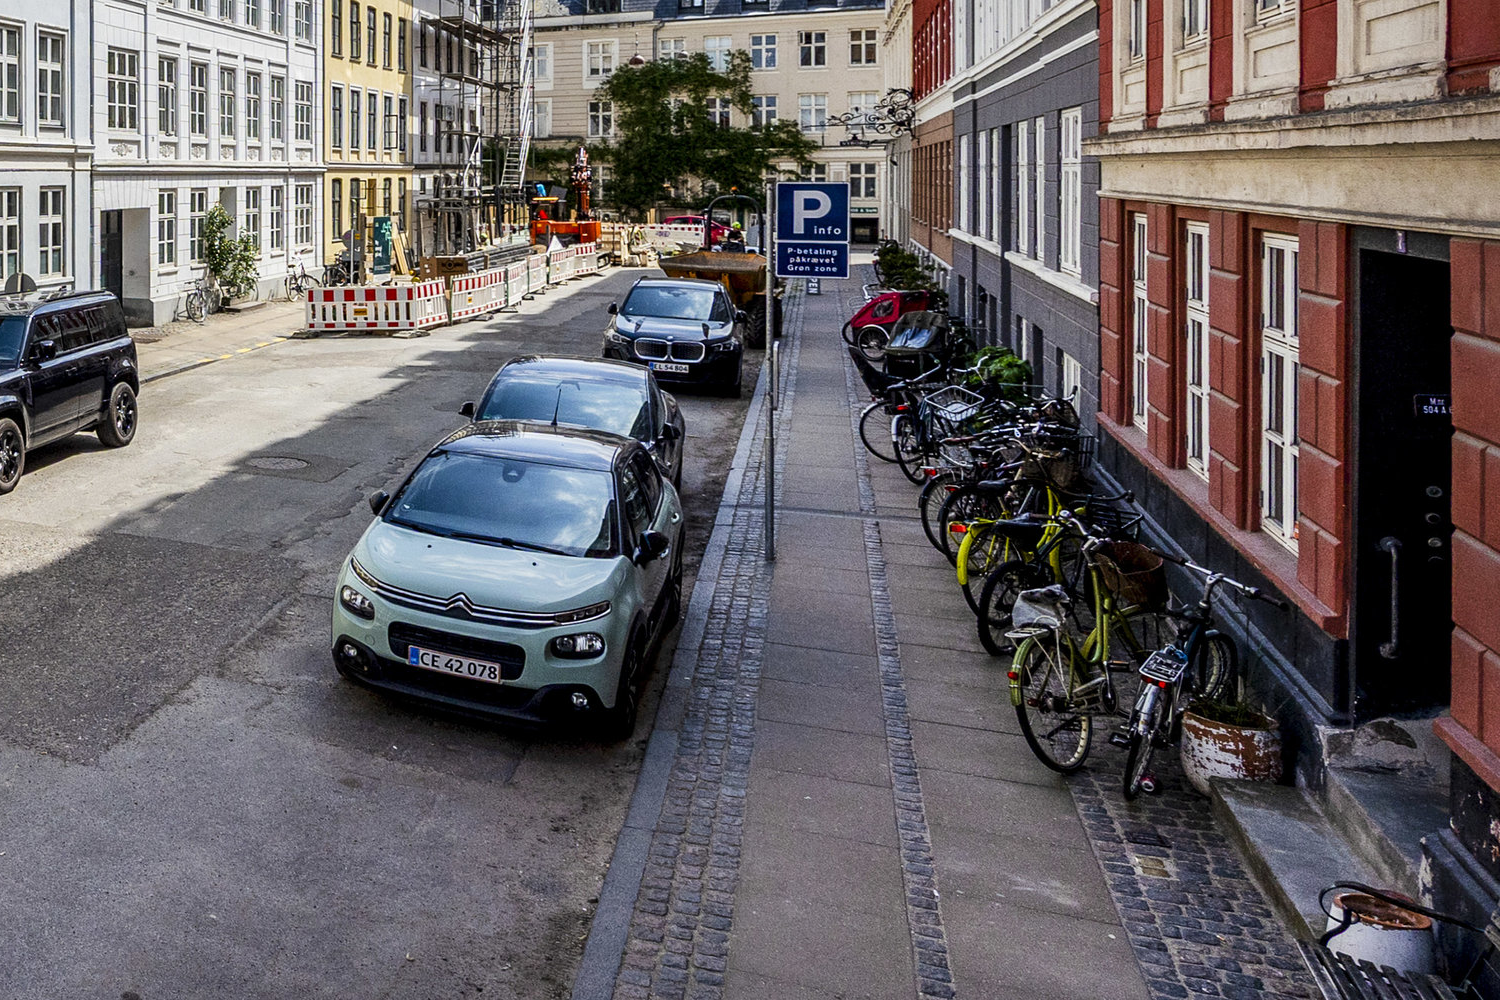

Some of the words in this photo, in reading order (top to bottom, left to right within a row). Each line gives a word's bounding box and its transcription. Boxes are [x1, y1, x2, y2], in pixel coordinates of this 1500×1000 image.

[793, 190, 832, 234] P
[814, 225, 842, 235] info
[787, 247, 838, 257] P-betaling
[789, 256, 835, 264] påkrævet
[808, 278, 818, 294] PEN
[420, 652, 440, 668] CE
[444, 658, 463, 674] 42
[467, 662, 498, 680] 078
